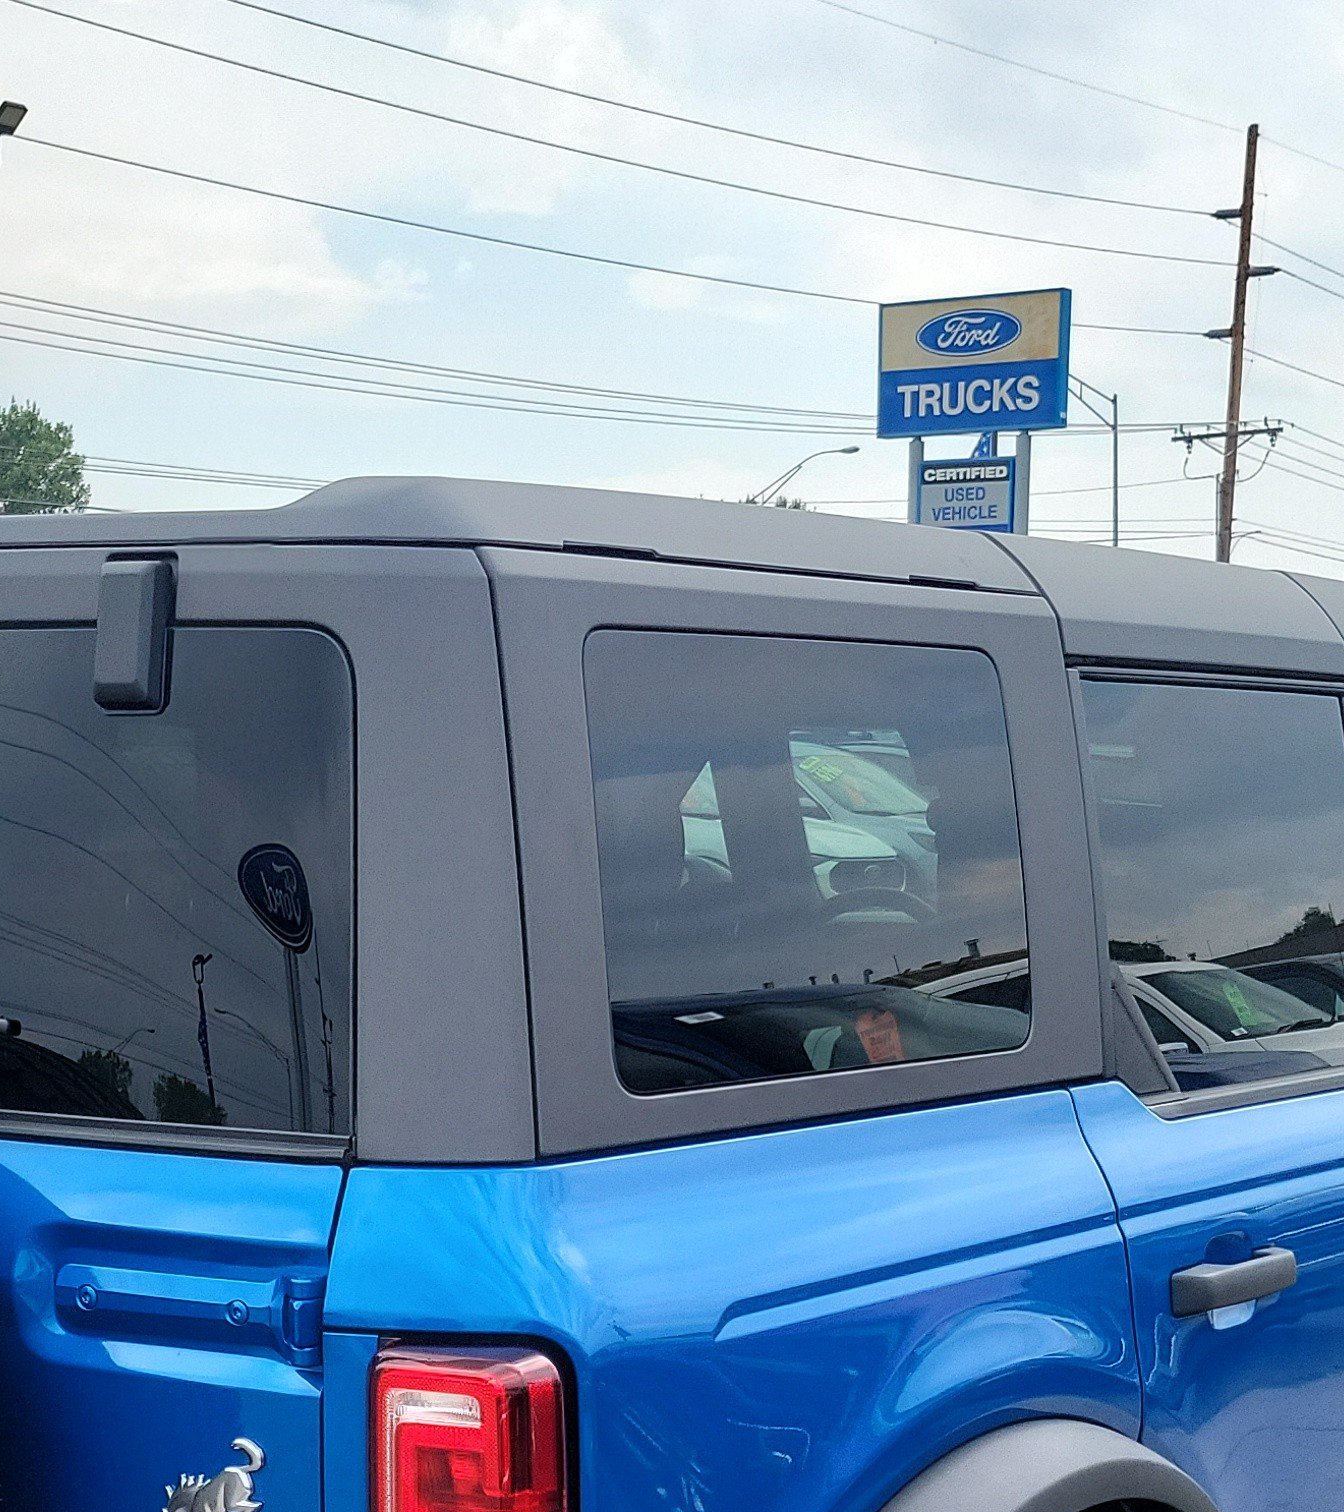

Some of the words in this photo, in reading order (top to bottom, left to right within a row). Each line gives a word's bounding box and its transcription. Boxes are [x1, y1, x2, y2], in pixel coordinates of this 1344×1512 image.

[937, 317, 1001, 348] Ford
[897, 375, 1040, 418] TRUCKS
[923, 465, 1008, 482] CERTIFIED
[944, 486, 986, 502] USED
[931, 505, 998, 522] VEHICLE
